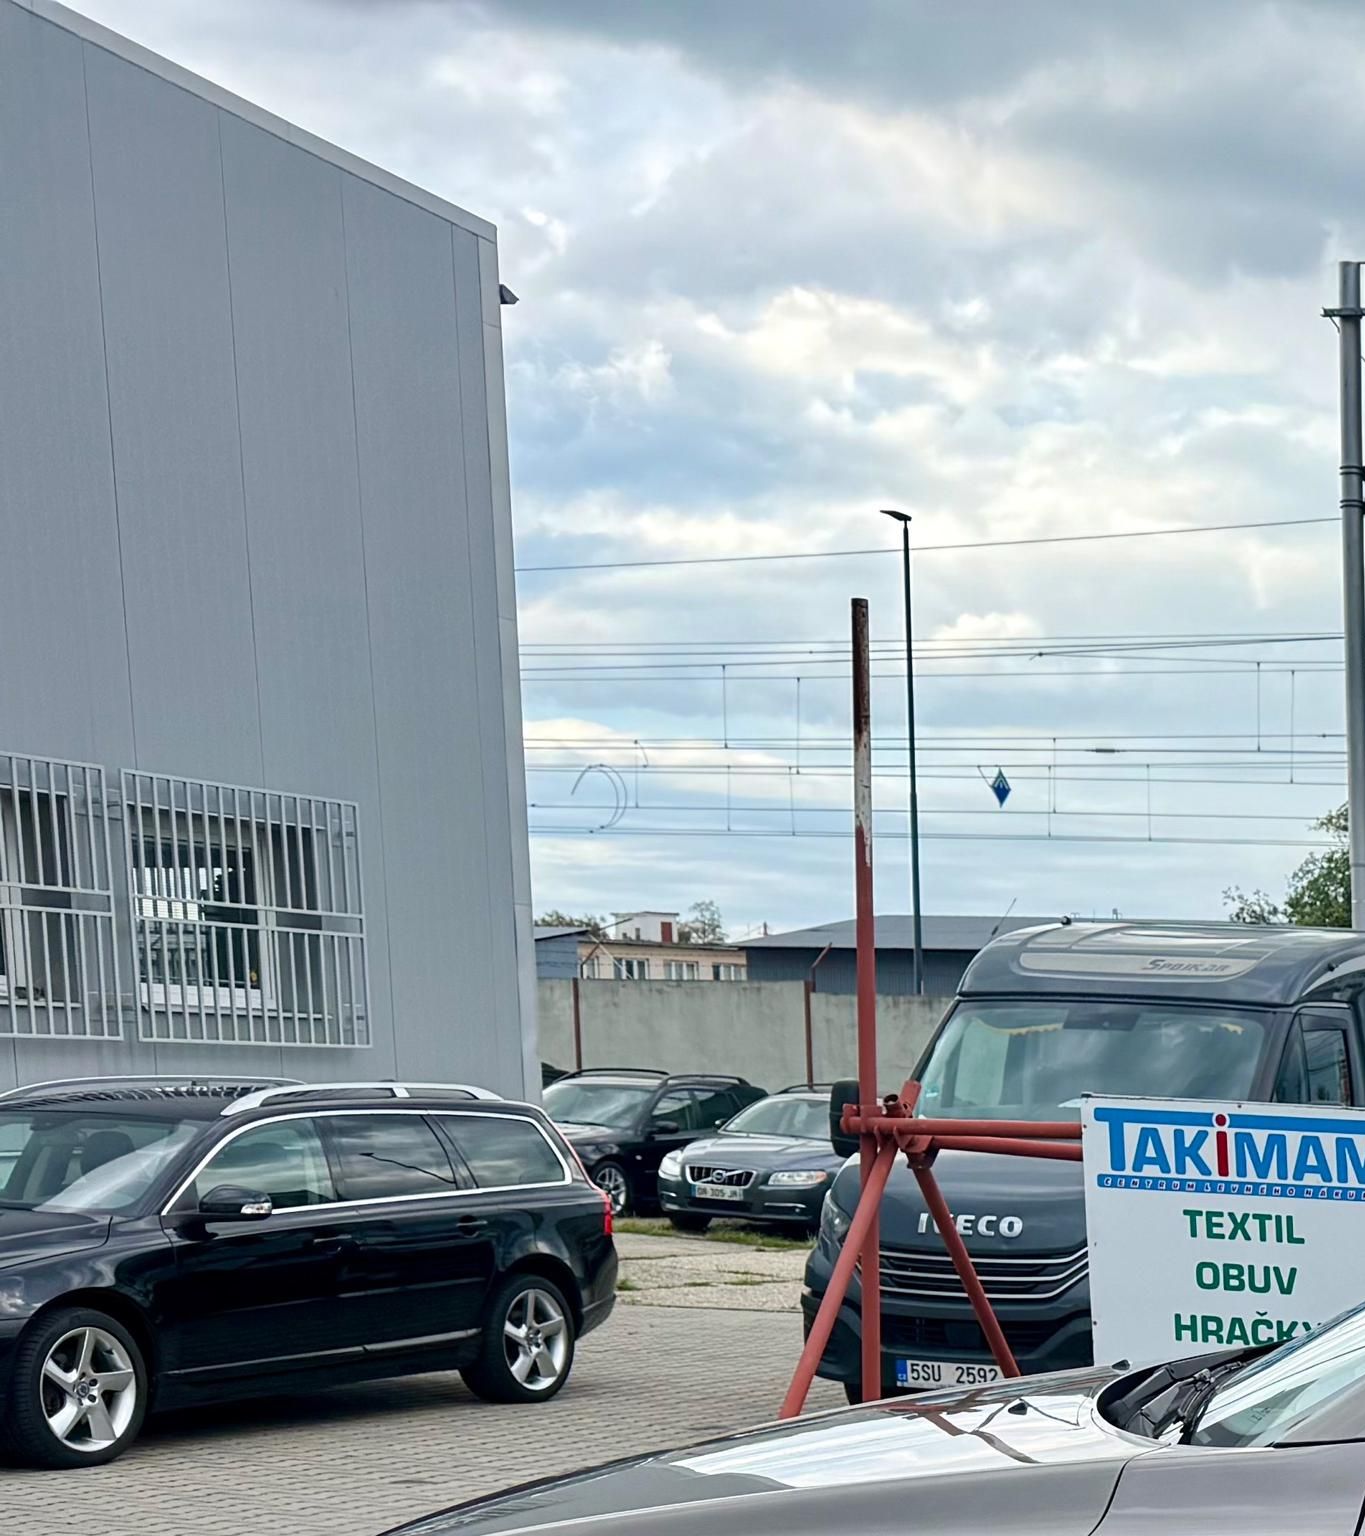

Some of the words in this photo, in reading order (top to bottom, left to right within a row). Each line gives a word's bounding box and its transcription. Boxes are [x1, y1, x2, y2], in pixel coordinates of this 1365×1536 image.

[1104, 1177, 1195, 1191] CENTRUM
[1182, 1209, 1306, 1245] TEXTIL
[1195, 1261, 1298, 1295] OBUV
[910, 1363, 942, 1382] 5SU
[955, 1366, 998, 1385] 2592
